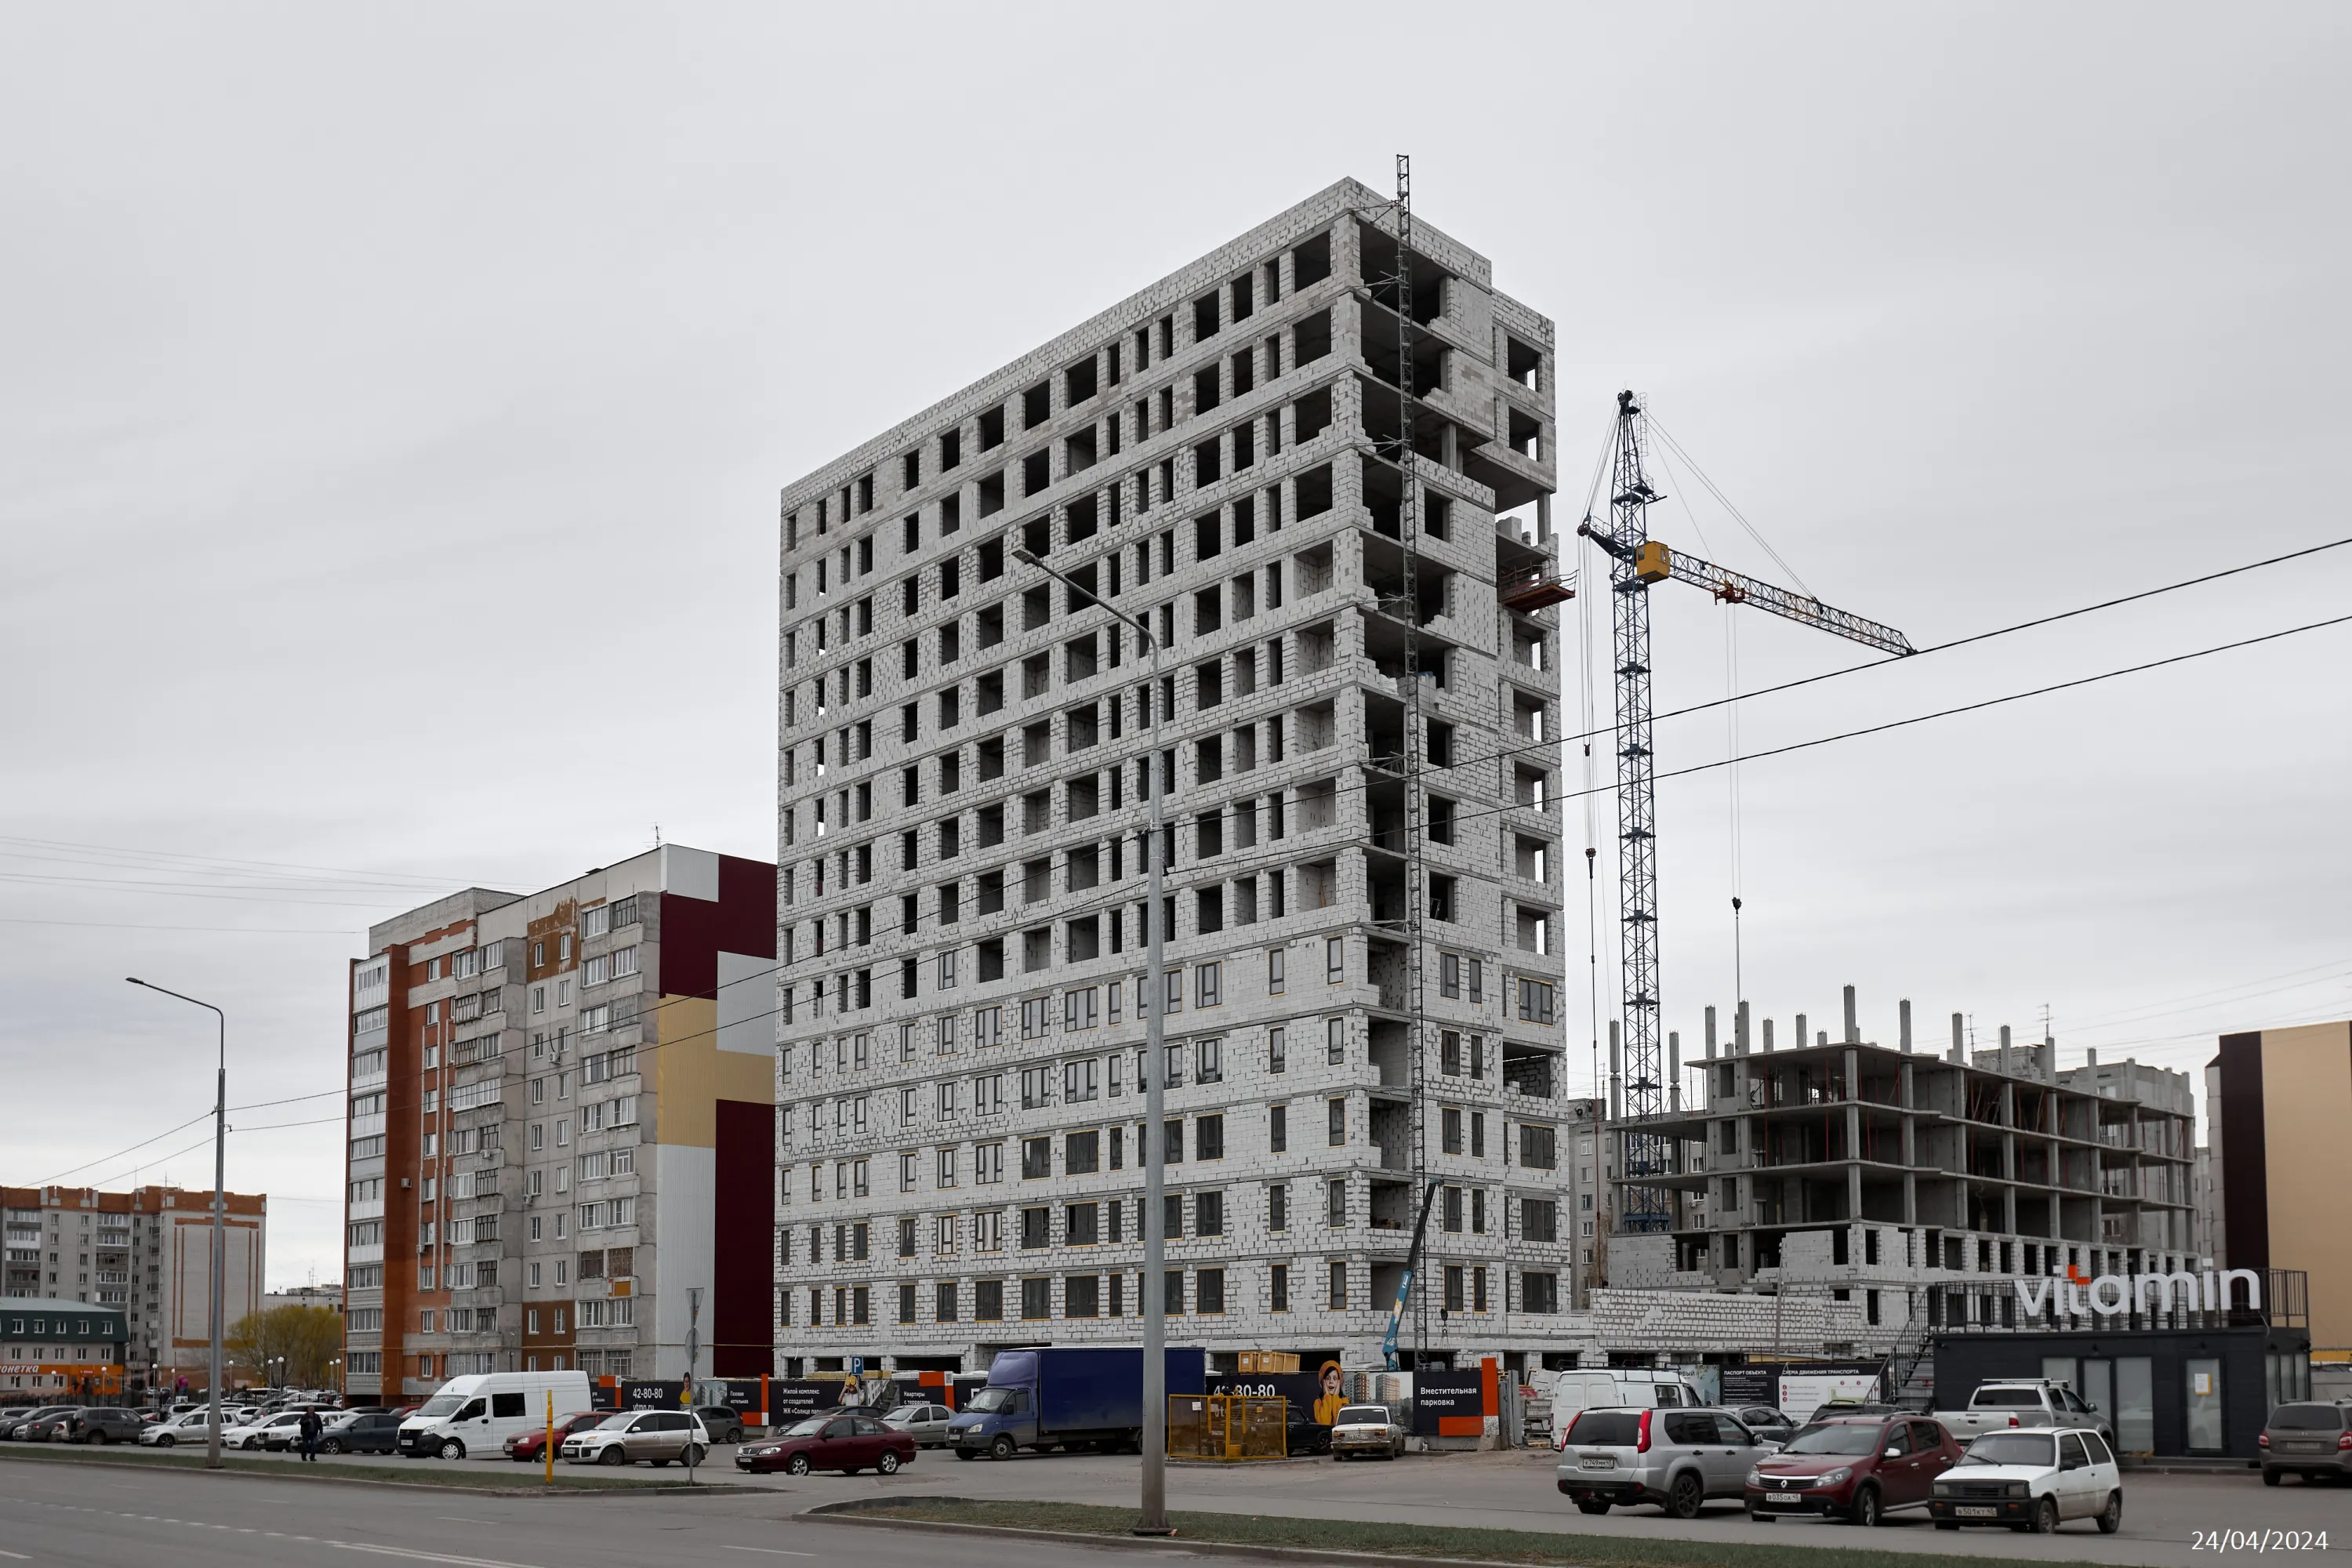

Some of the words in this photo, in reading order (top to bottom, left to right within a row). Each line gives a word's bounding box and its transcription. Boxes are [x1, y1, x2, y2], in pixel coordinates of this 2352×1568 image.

[2014, 1258, 2262, 1316] vitamin
[854, 1357, 861, 1373] P
[633, 1388, 663, 1399] 42-80-80
